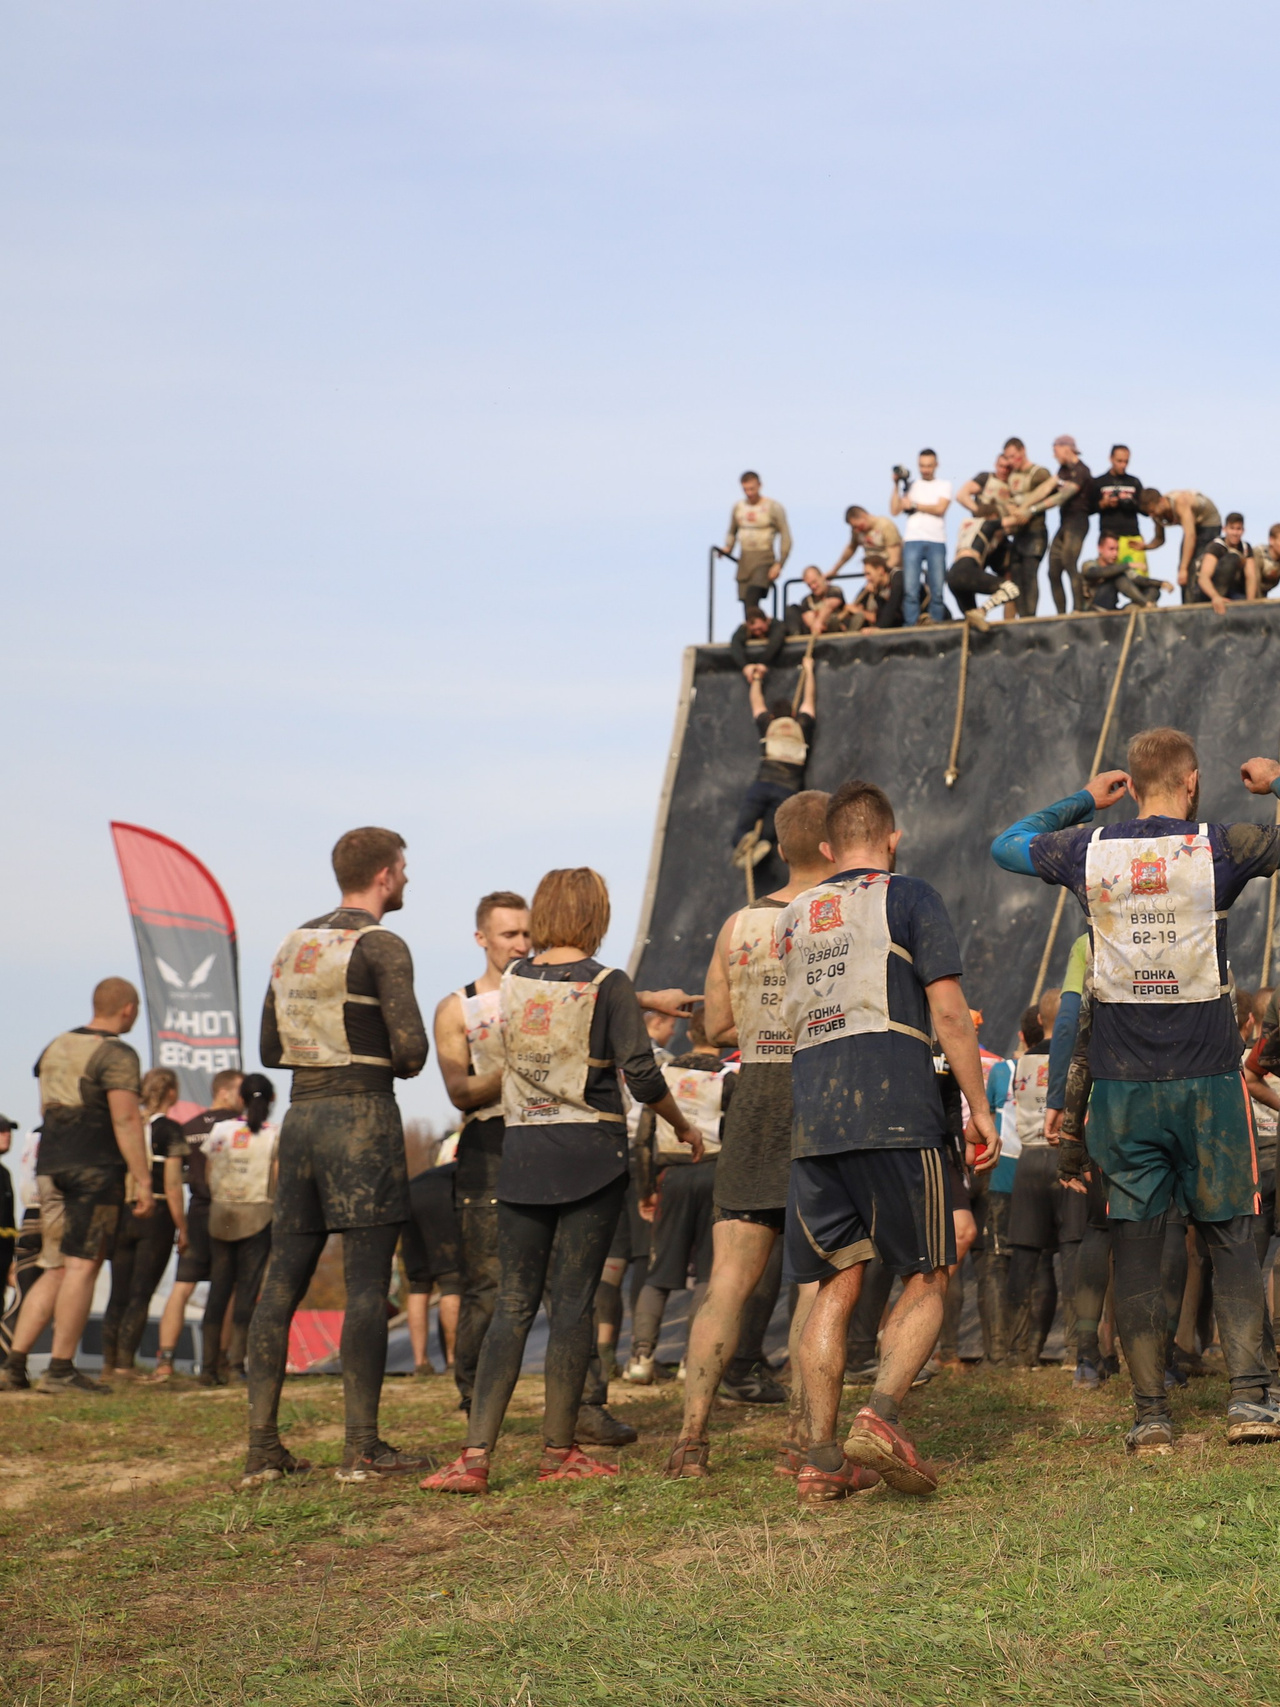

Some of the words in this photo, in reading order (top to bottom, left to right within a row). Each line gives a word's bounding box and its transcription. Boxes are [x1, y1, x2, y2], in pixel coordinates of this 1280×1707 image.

[1131, 912, 1176, 925] ВЗВОД
[1132, 930, 1177, 945] 62-19
[808, 943, 849, 965] ВЗВОД
[763, 975, 787, 986] ВЗВ
[806, 961, 846, 986] 62-09
[1134, 970, 1176, 980] ГОНКА
[1133, 985, 1180, 995] ГЕРОЕВ
[760, 992, 783, 1006] 62-
[807, 1003, 842, 1021] ГОНКА
[807, 1017, 847, 1038] ГЕРОЕВ
